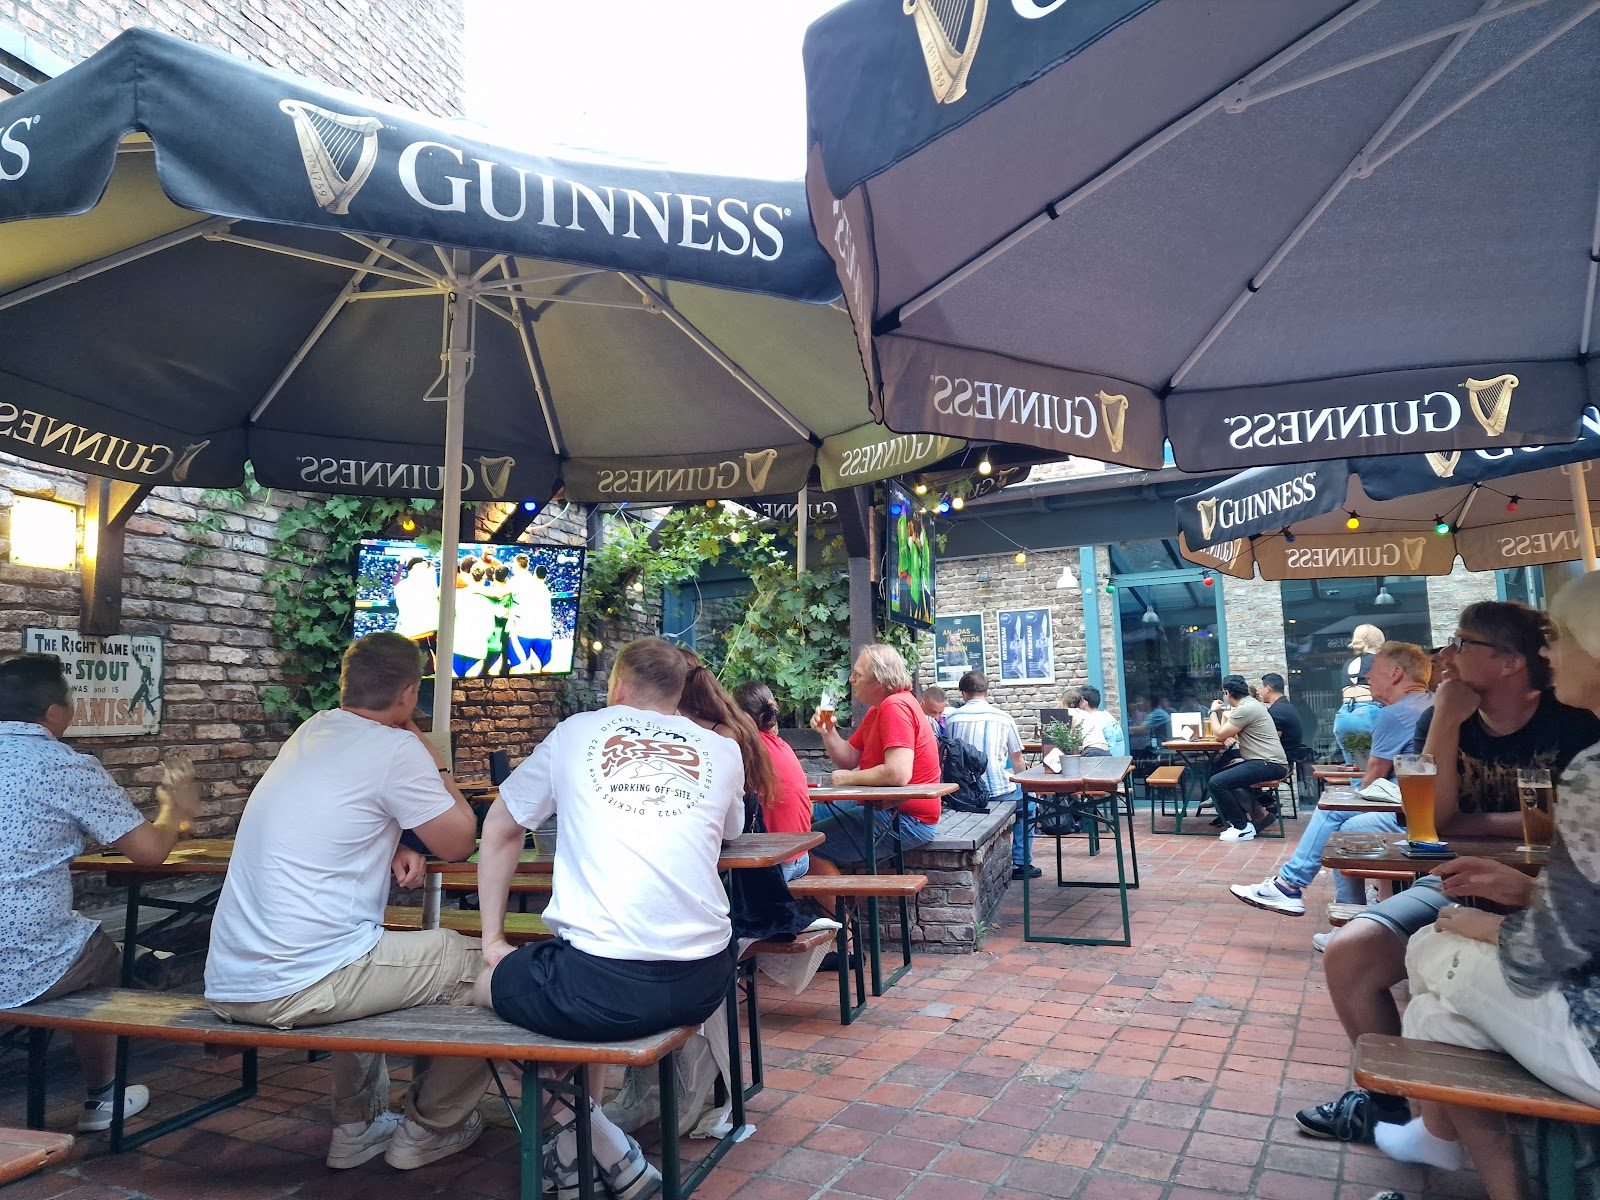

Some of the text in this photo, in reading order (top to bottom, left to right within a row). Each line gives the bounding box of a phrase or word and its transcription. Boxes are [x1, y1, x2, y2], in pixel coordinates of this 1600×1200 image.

[398, 140, 785, 262] GUINNESS
[1219, 472, 1316, 529] GUINNESS
[957, 628, 971, 636] DAS
[35, 633, 129, 656] THE RIGHT NAME
[76, 659, 130, 681] STOUT
[71, 698, 144, 727] AMISH
[586, 739, 598, 762] 1922
[610, 783, 692, 800] WORKING OFF-SITE
[602, 793, 646, 816] DICKIES
